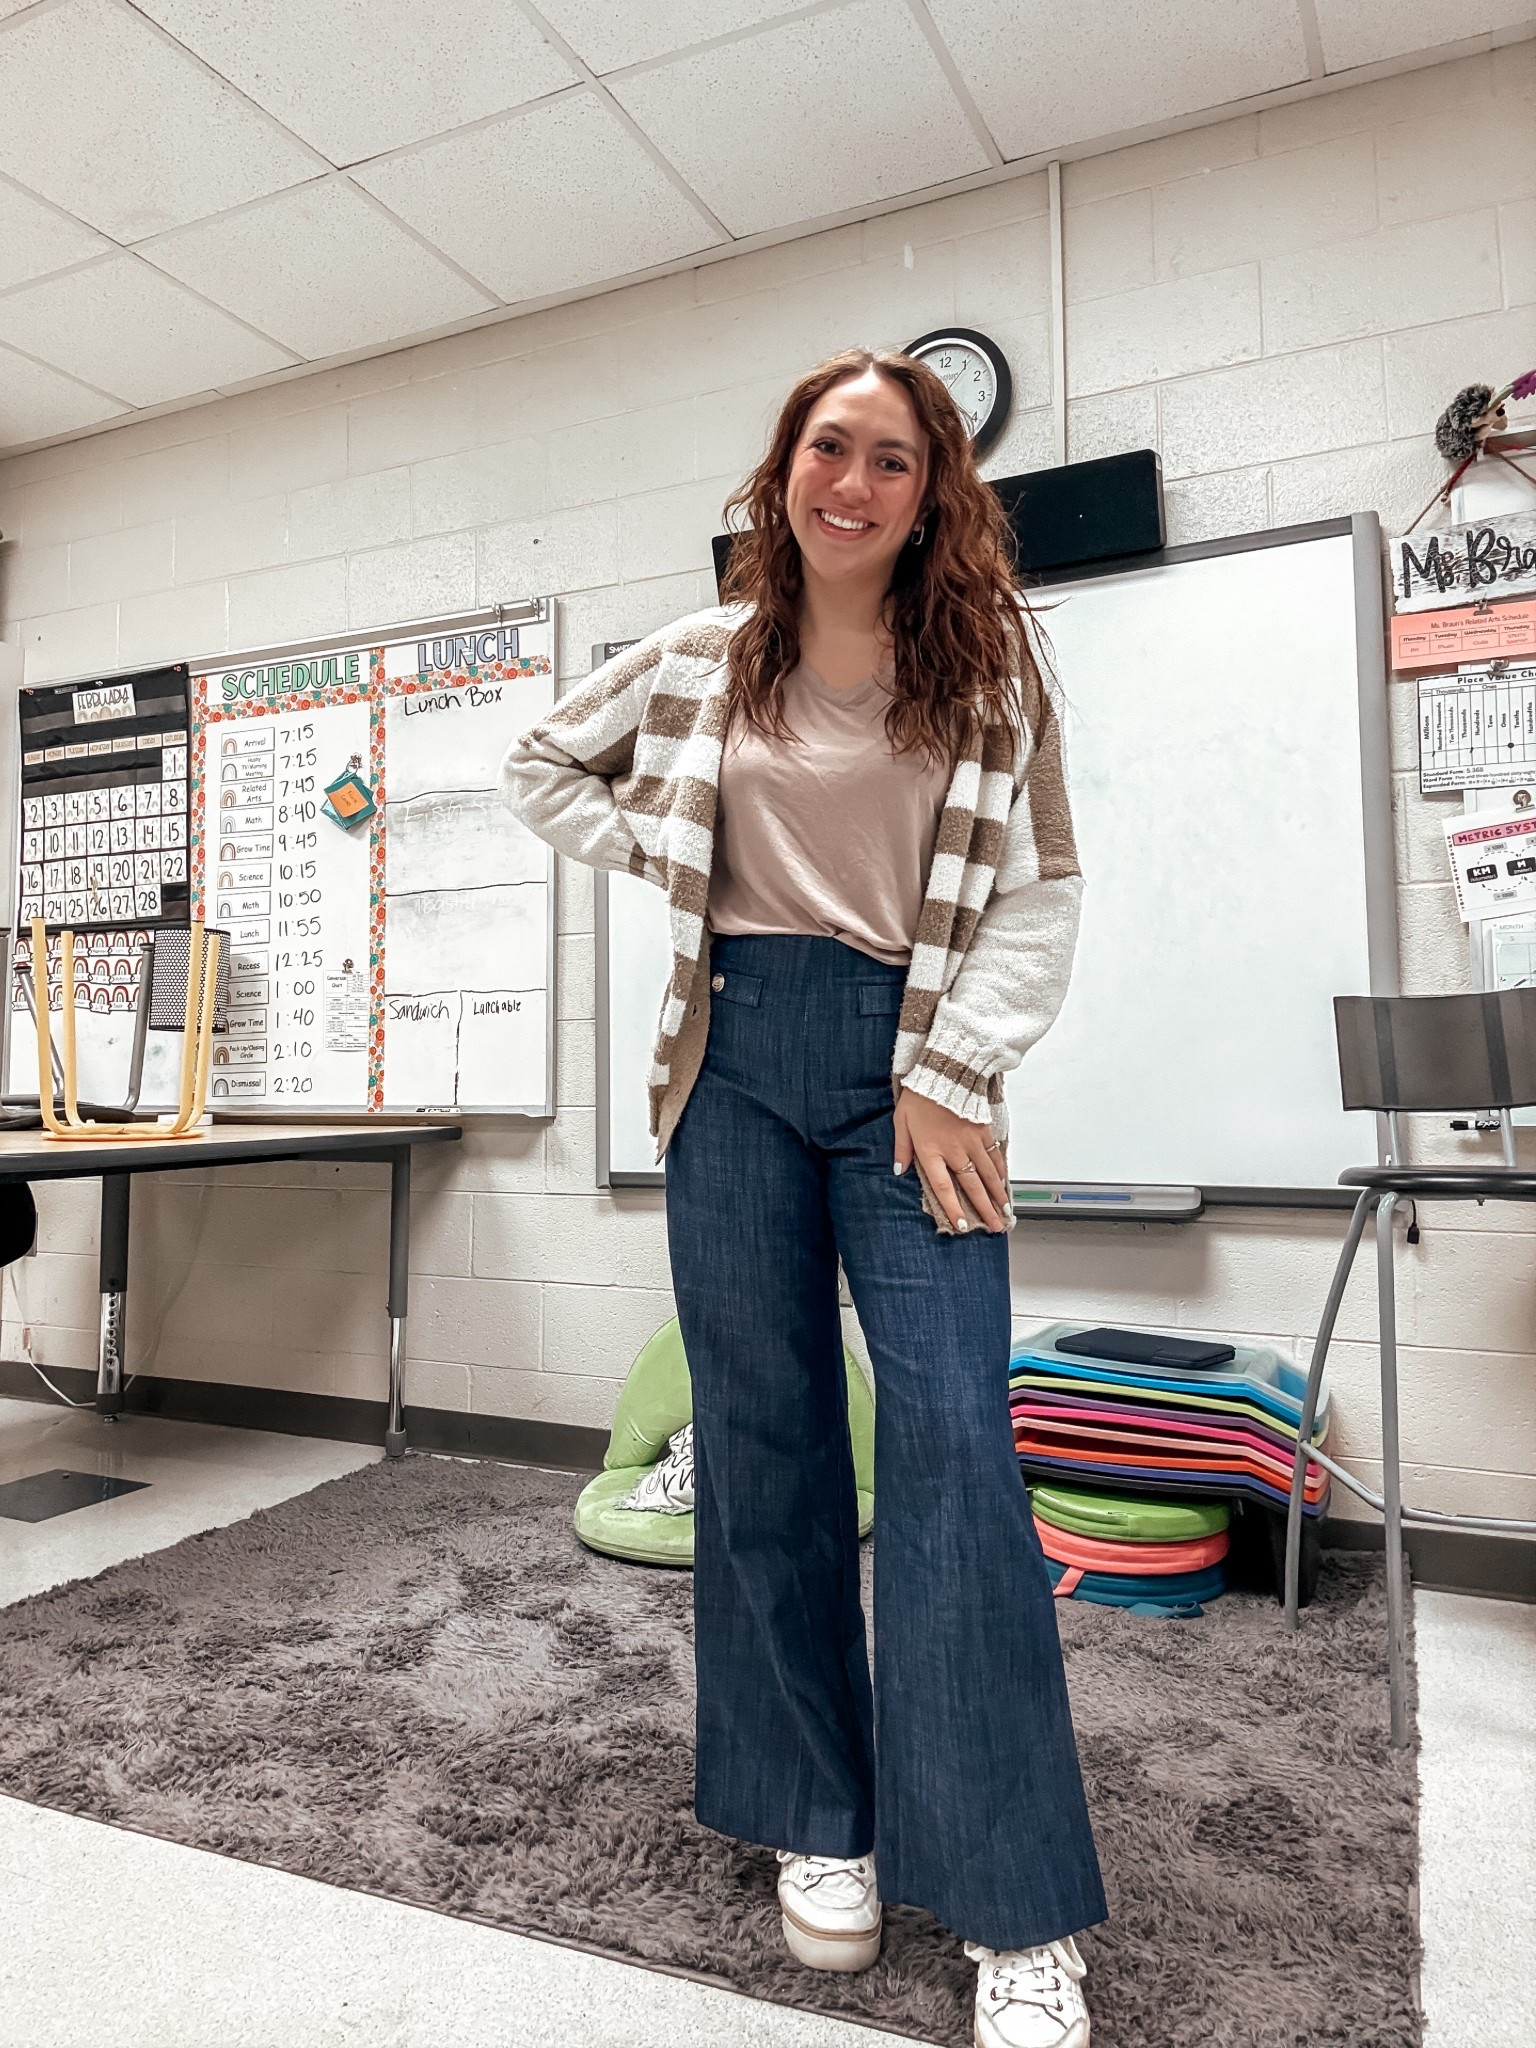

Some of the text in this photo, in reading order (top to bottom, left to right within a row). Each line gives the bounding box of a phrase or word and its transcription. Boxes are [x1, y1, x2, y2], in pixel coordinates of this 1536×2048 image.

[939, 356, 952, 368] 12
[962, 360, 967, 370] 1
[973, 370, 981, 382] 2
[978, 390, 986, 402] 3
[971, 411, 978, 422] 4
[417, 628, 519, 673] LUNCH
[222, 654, 360, 700] SCHEDULE
[404, 686, 503, 716] Lunch Box
[244, 737, 266, 747] Arrival
[280, 724, 314, 744] 7:15
[280, 748, 317, 769] 7:25
[242, 783, 266, 792] Related
[279, 776, 315, 797] 7:45
[31, 788, 178, 823] 2 3 4 5 6 7 8
[278, 801, 316, 823] 8:40
[30, 822, 180, 856] 9 10 11 12 13 14 15
[279, 832, 317, 851] 9:45
[1458, 829, 1502, 843] METRIC
[255, 844, 271, 852] Time
[28, 856, 184, 889] 16 17 18 19 20 21 22
[279, 861, 316, 880] 10:15
[1472, 860, 1526, 876] KM M
[24, 891, 157, 921] 23 24 25 26 27 28
[279, 889, 322, 909] 10:50
[279, 916, 321, 937] 11:55
[238, 962, 260, 970] Recess
[275, 950, 324, 971] 12:25
[236, 990, 262, 998] Science
[276, 980, 315, 998] 1:00
[276, 1009, 314, 1028] 1:40
[389, 1000, 450, 1021] Sandwich
[230, 1018, 264, 1028] Grow Time
[274, 1041, 312, 1060] 2:10
[231, 1079, 262, 1088] Dismissal
[273, 1076, 313, 1093] 2:20
